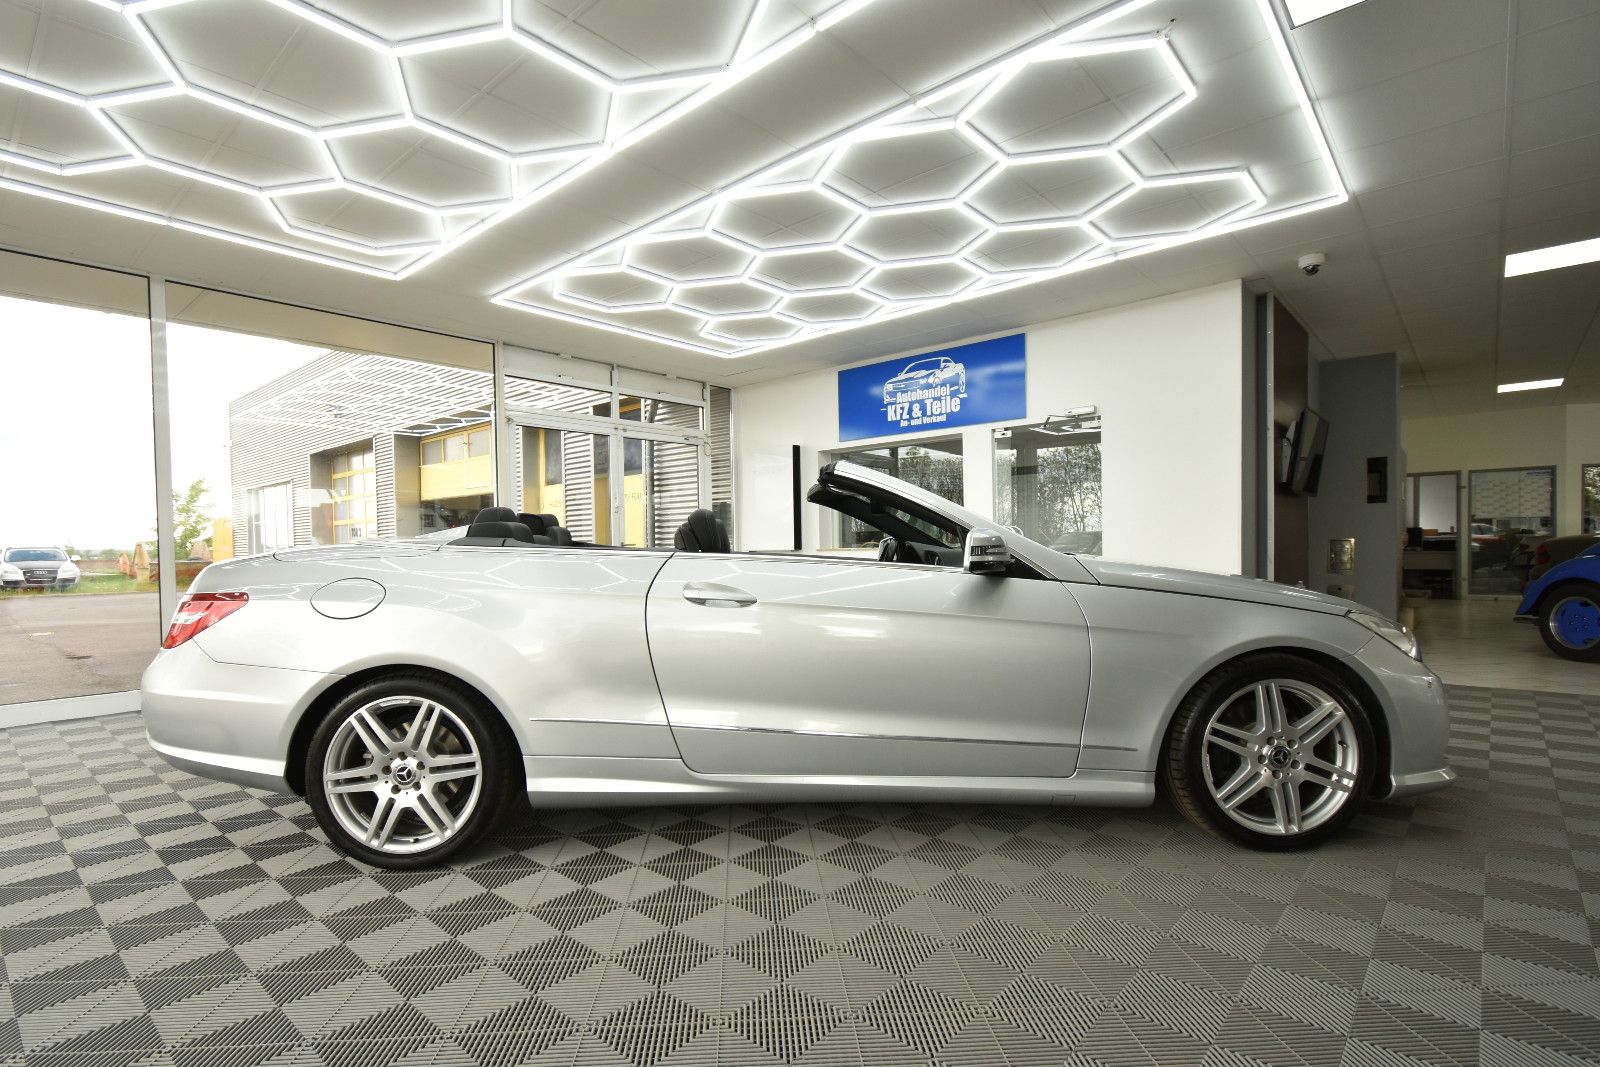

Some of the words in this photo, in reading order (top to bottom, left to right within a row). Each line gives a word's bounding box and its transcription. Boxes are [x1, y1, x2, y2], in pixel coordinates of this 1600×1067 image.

[896, 384, 950, 403] Autohandel
[887, 402, 910, 421] KFZ
[912, 403, 922, 418] &
[925, 396, 961, 416] Teile
[900, 419, 910, 427] An-
[911, 416, 922, 426] und
[923, 414, 947, 424] Verkauf
